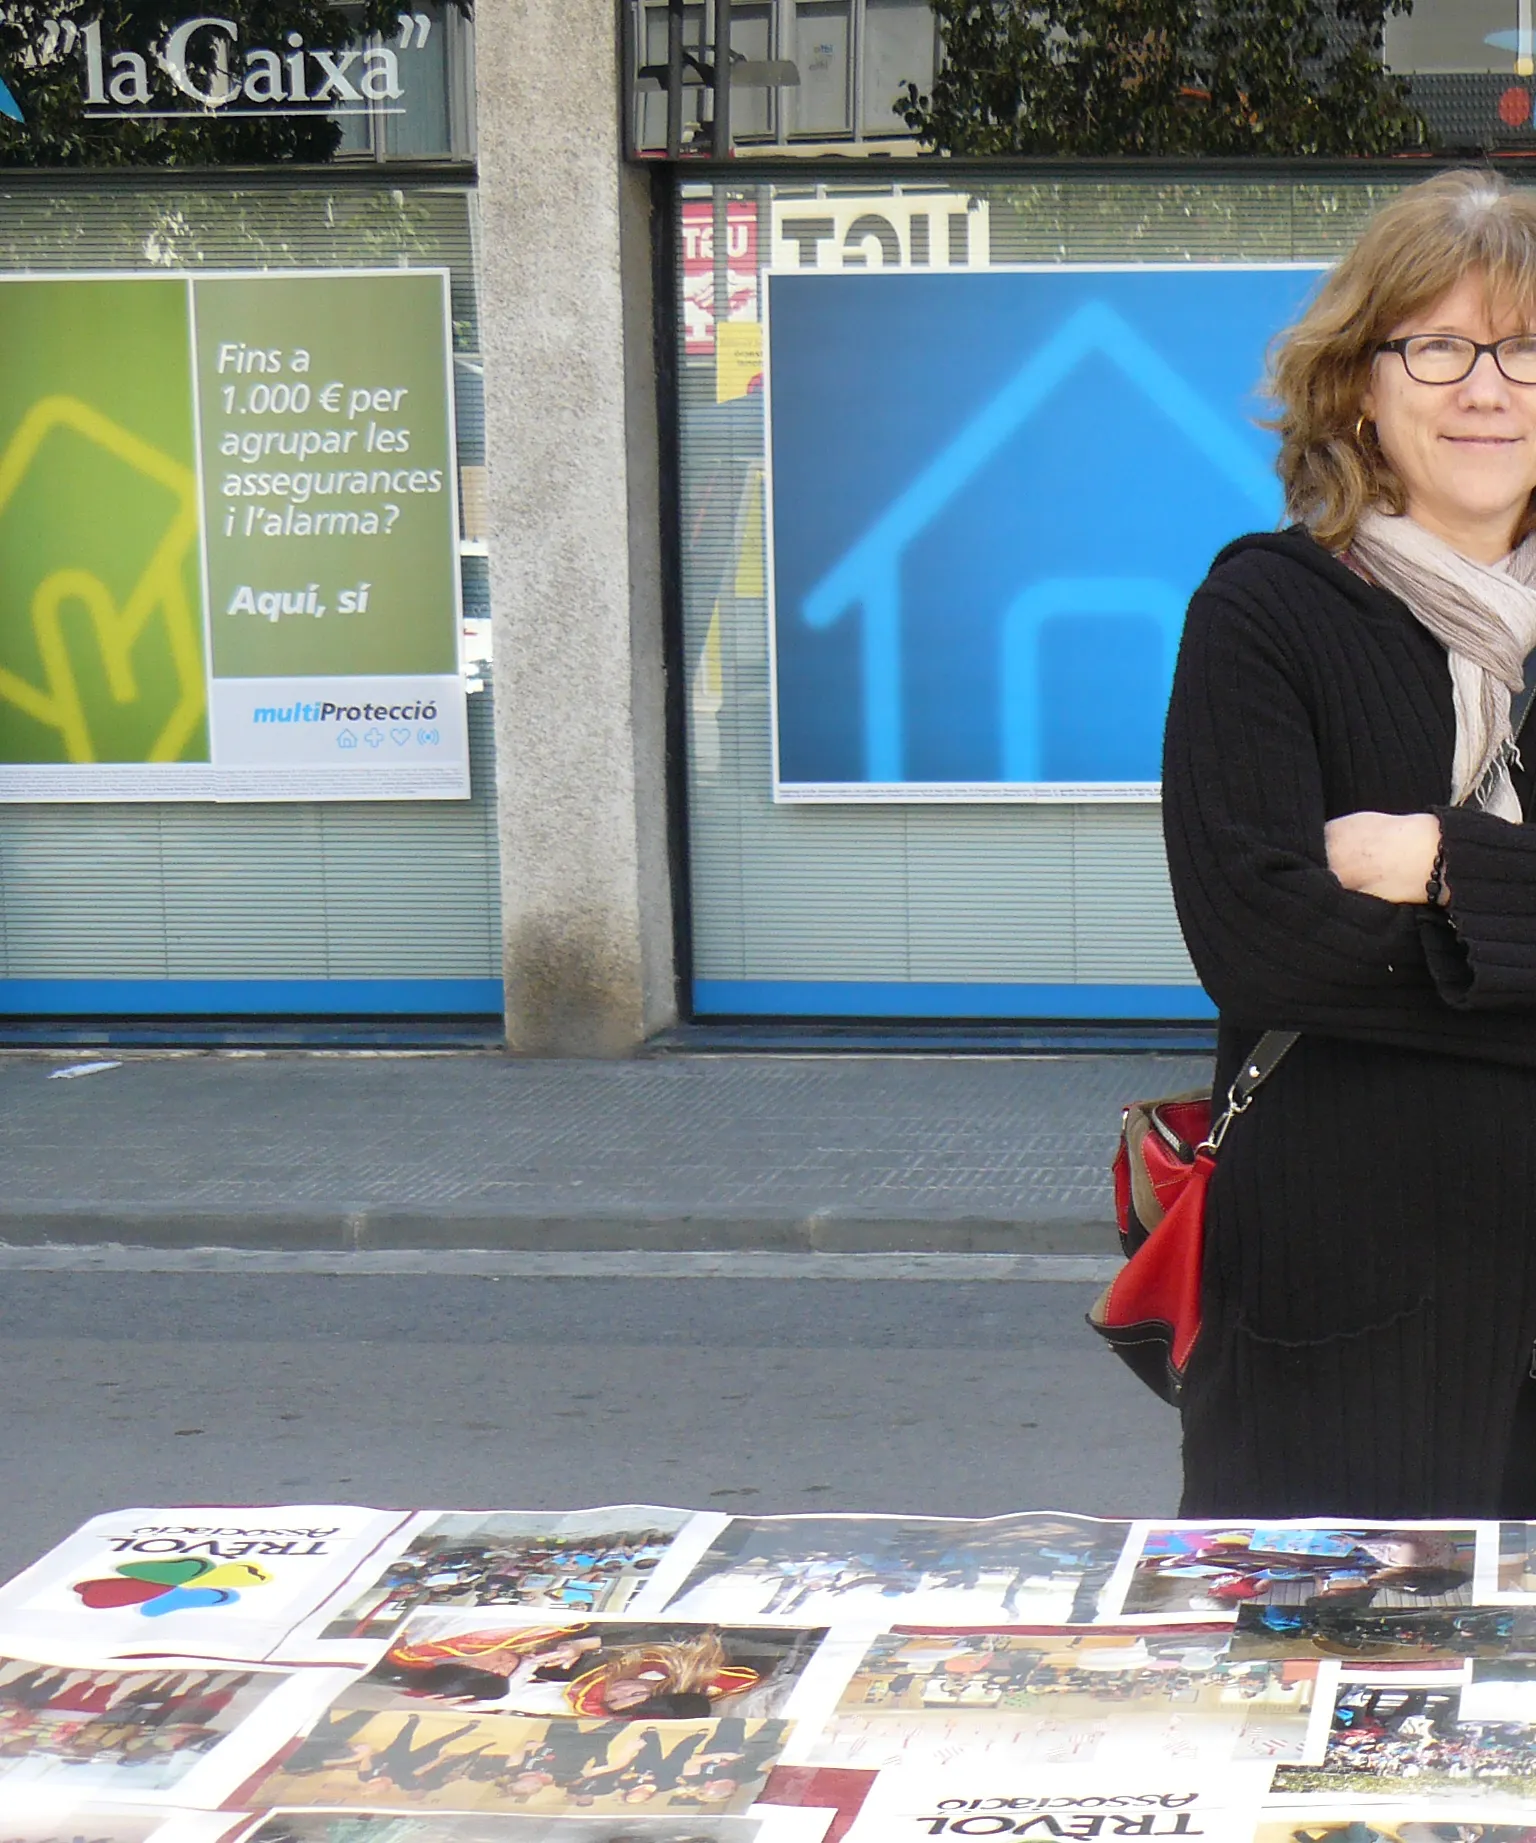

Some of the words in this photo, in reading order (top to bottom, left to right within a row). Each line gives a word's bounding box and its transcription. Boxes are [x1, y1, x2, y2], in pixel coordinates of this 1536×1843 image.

[217, 342, 282, 374] Fins
[290, 349, 311, 373] a
[222, 382, 311, 415] 1.000
[318, 382, 344, 413] €
[348, 387, 408, 420] per
[221, 430, 358, 464] agrupar
[366, 422, 411, 454] les
[223, 468, 443, 503] assegurances
[225, 506, 236, 537] i
[245, 503, 401, 538] l'alarma?
[227, 583, 326, 623] Aquí,
[338, 582, 372, 614] sí
[252, 700, 438, 723] multiProtecció
[131, 1526, 341, 1538] Associació
[107, 1538, 329, 1559] TRÈVOL
[937, 1792, 1200, 1814] Associació
[916, 1813, 1205, 1842] TRÈVOL
